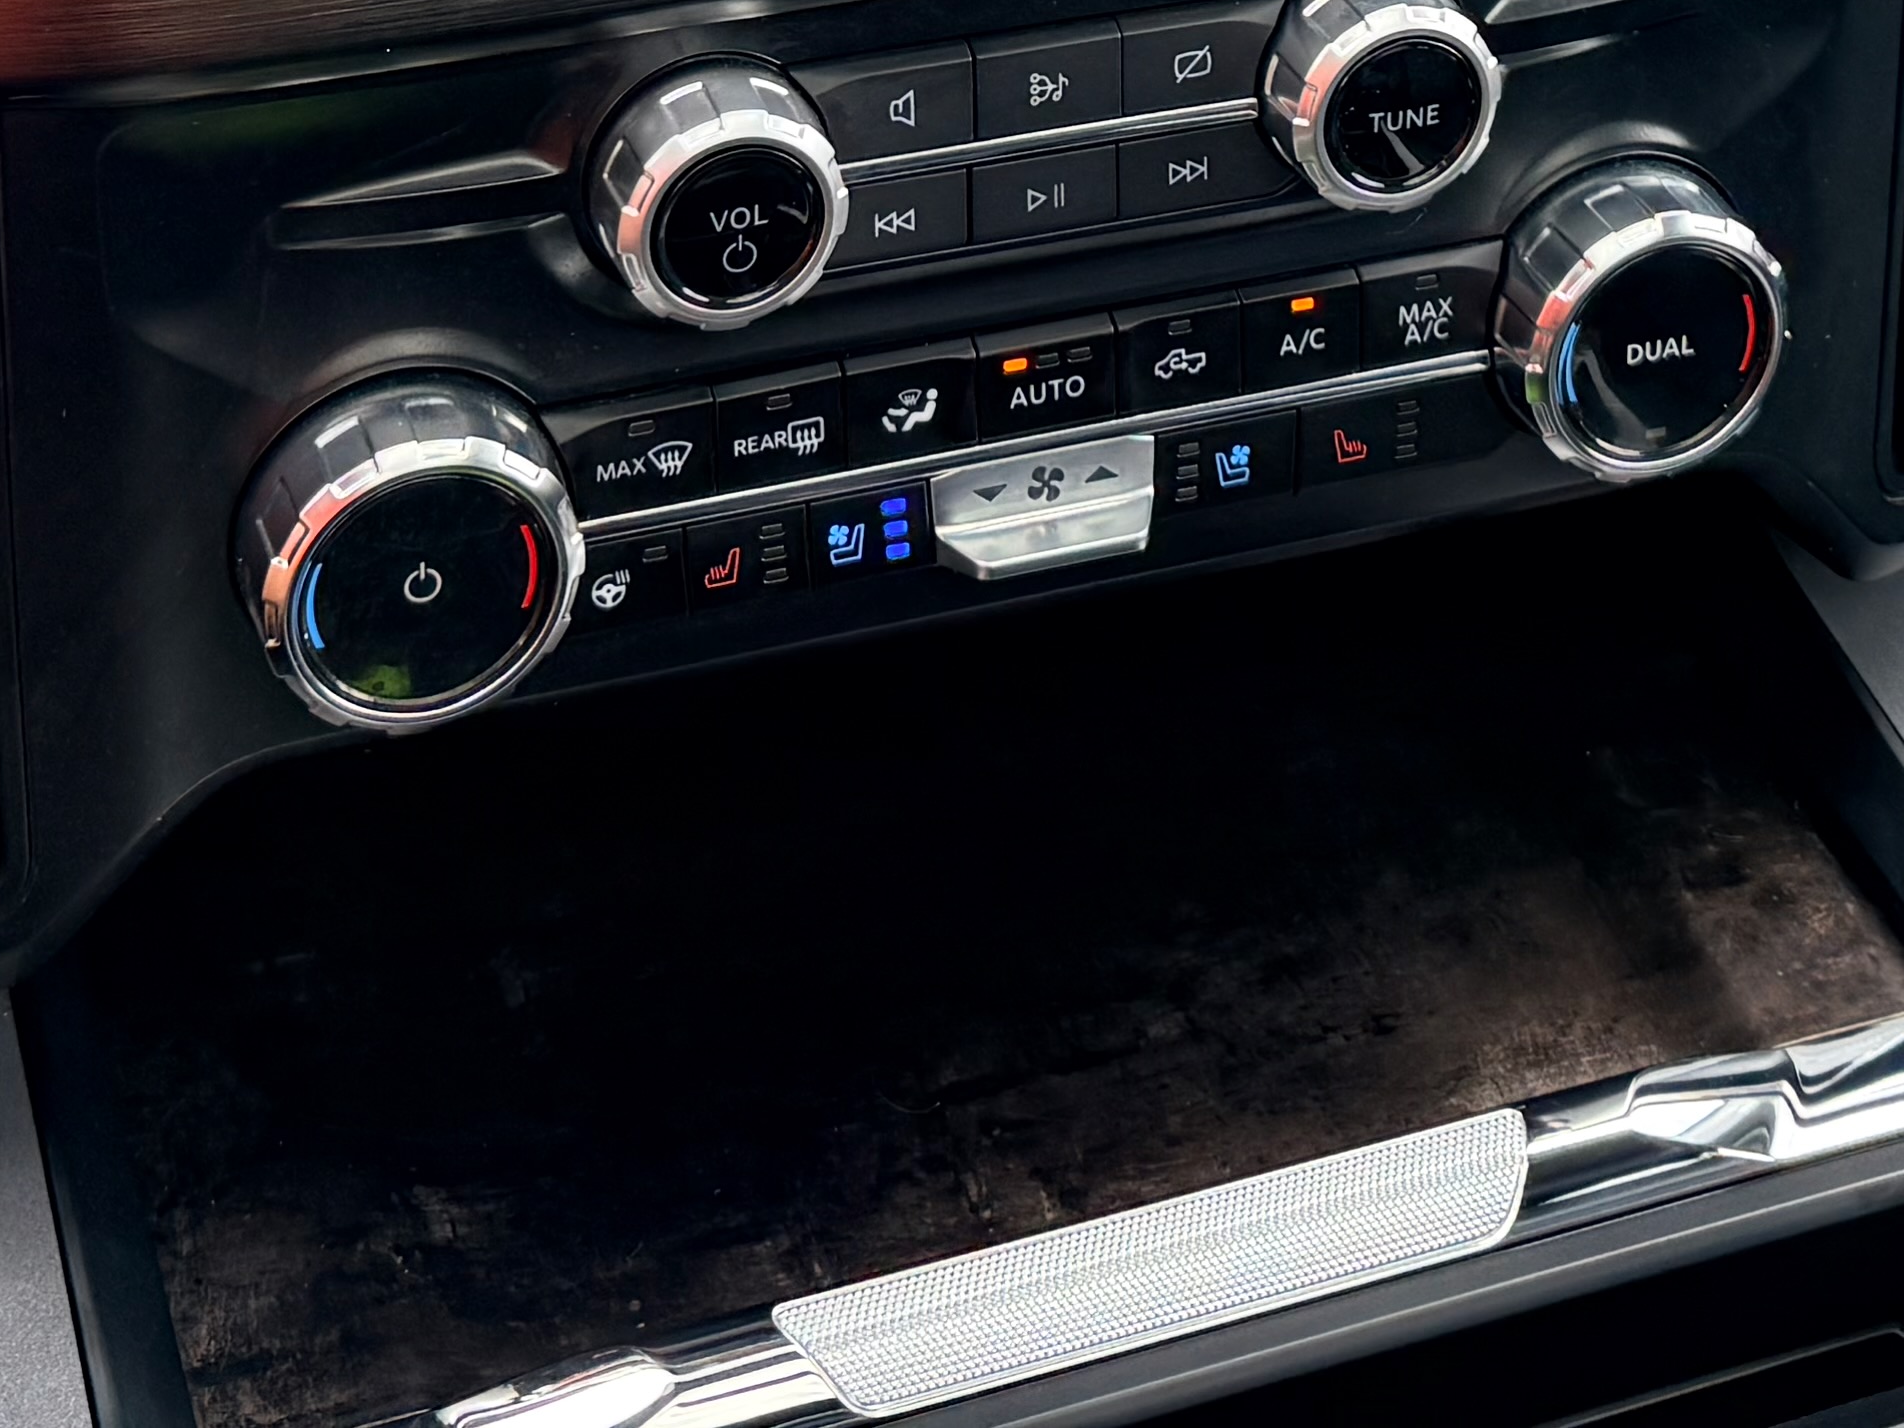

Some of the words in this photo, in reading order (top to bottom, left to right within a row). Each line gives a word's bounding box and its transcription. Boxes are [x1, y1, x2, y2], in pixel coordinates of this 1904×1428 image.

[1368, 103, 1441, 134] TUNE
[709, 203, 770, 233] VOL
[1398, 296, 1454, 327] MAX
[1279, 328, 1326, 357] A/C
[1404, 317, 1451, 347] A/C
[1625, 334, 1695, 366] DUAL
[1009, 374, 1086, 409] AUTO
[732, 431, 787, 458] REAR
[595, 455, 648, 483] MAX
